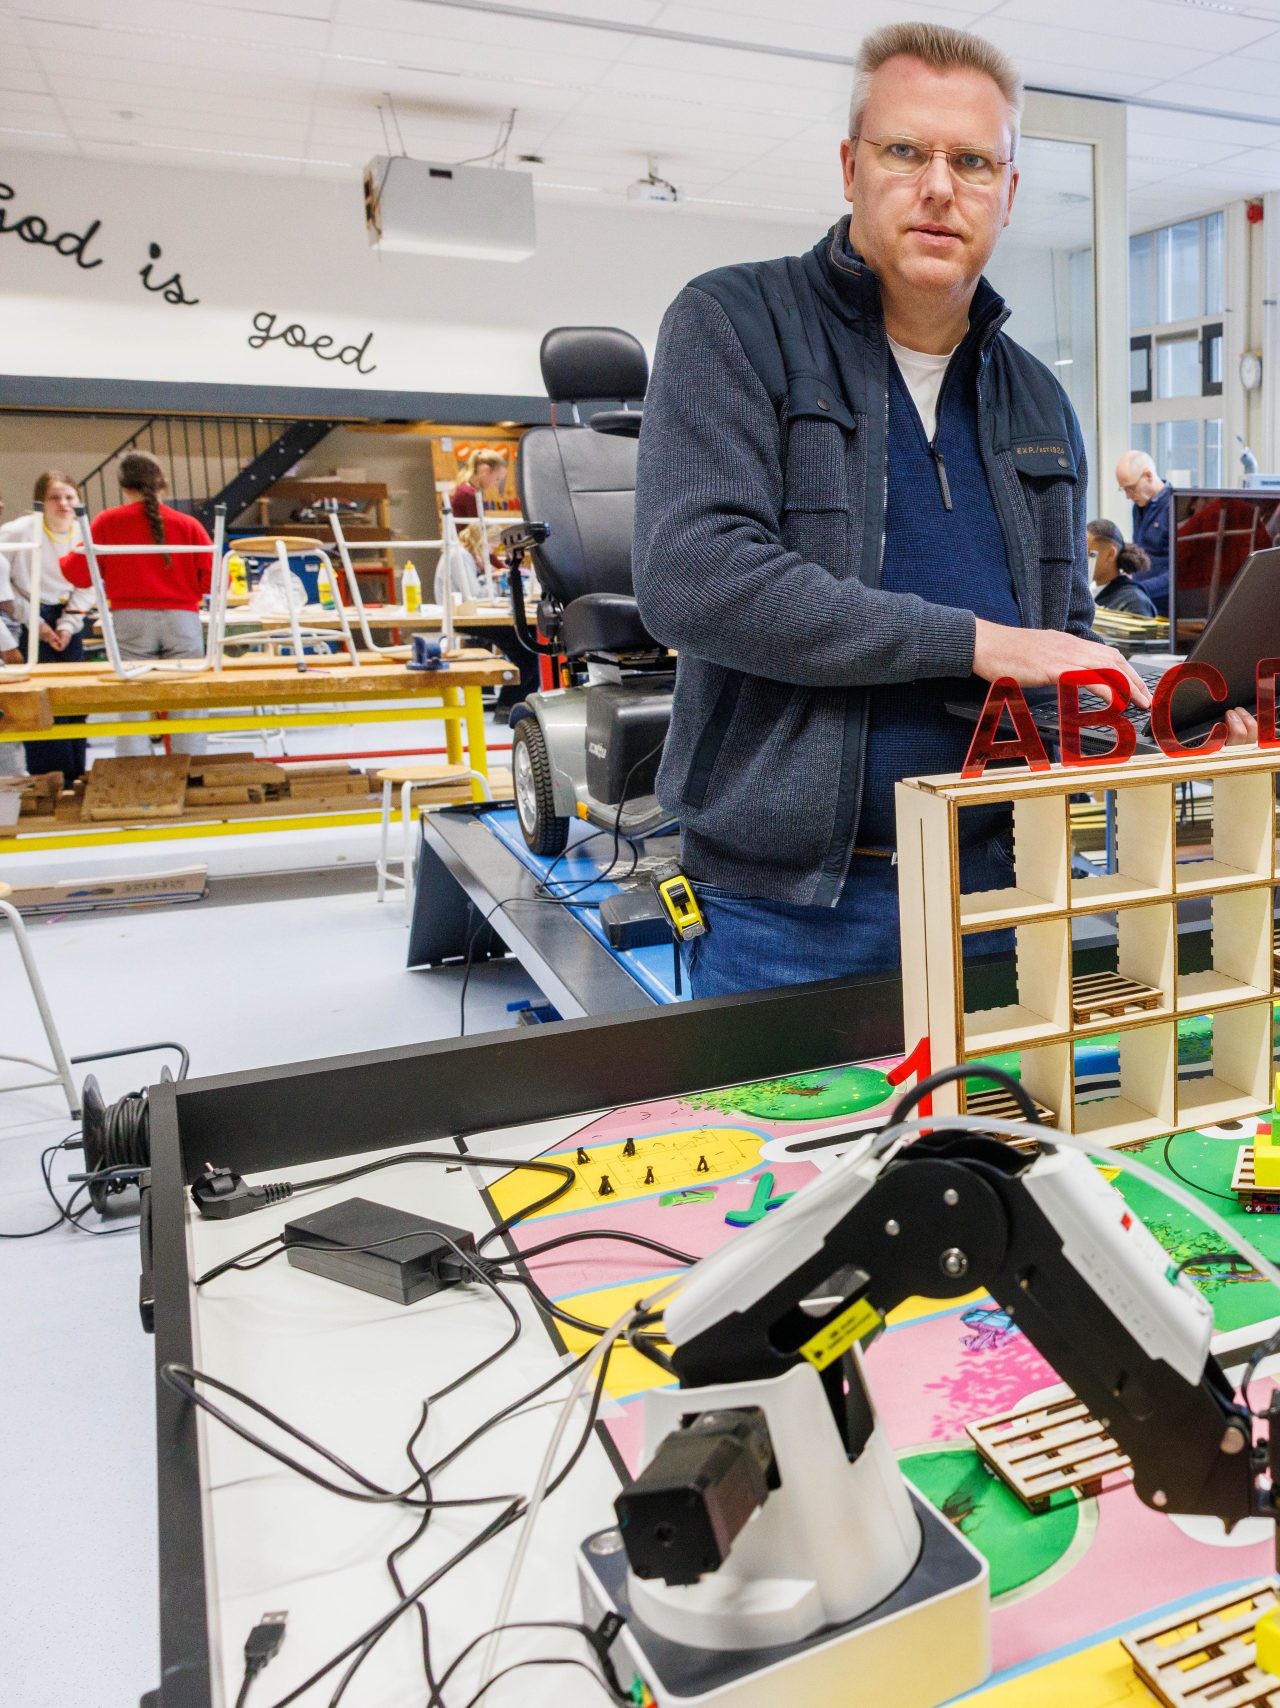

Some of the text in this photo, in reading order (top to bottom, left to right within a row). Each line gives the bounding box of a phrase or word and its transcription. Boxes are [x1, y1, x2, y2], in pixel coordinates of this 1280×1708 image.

[139, 242, 199, 305] is
[248, 312, 377, 374] goed
[960, 676, 1052, 779] A
[1057, 667, 1137, 767] B
[1150, 661, 1229, 758] C
[886, 1036, 933, 1137] 1
